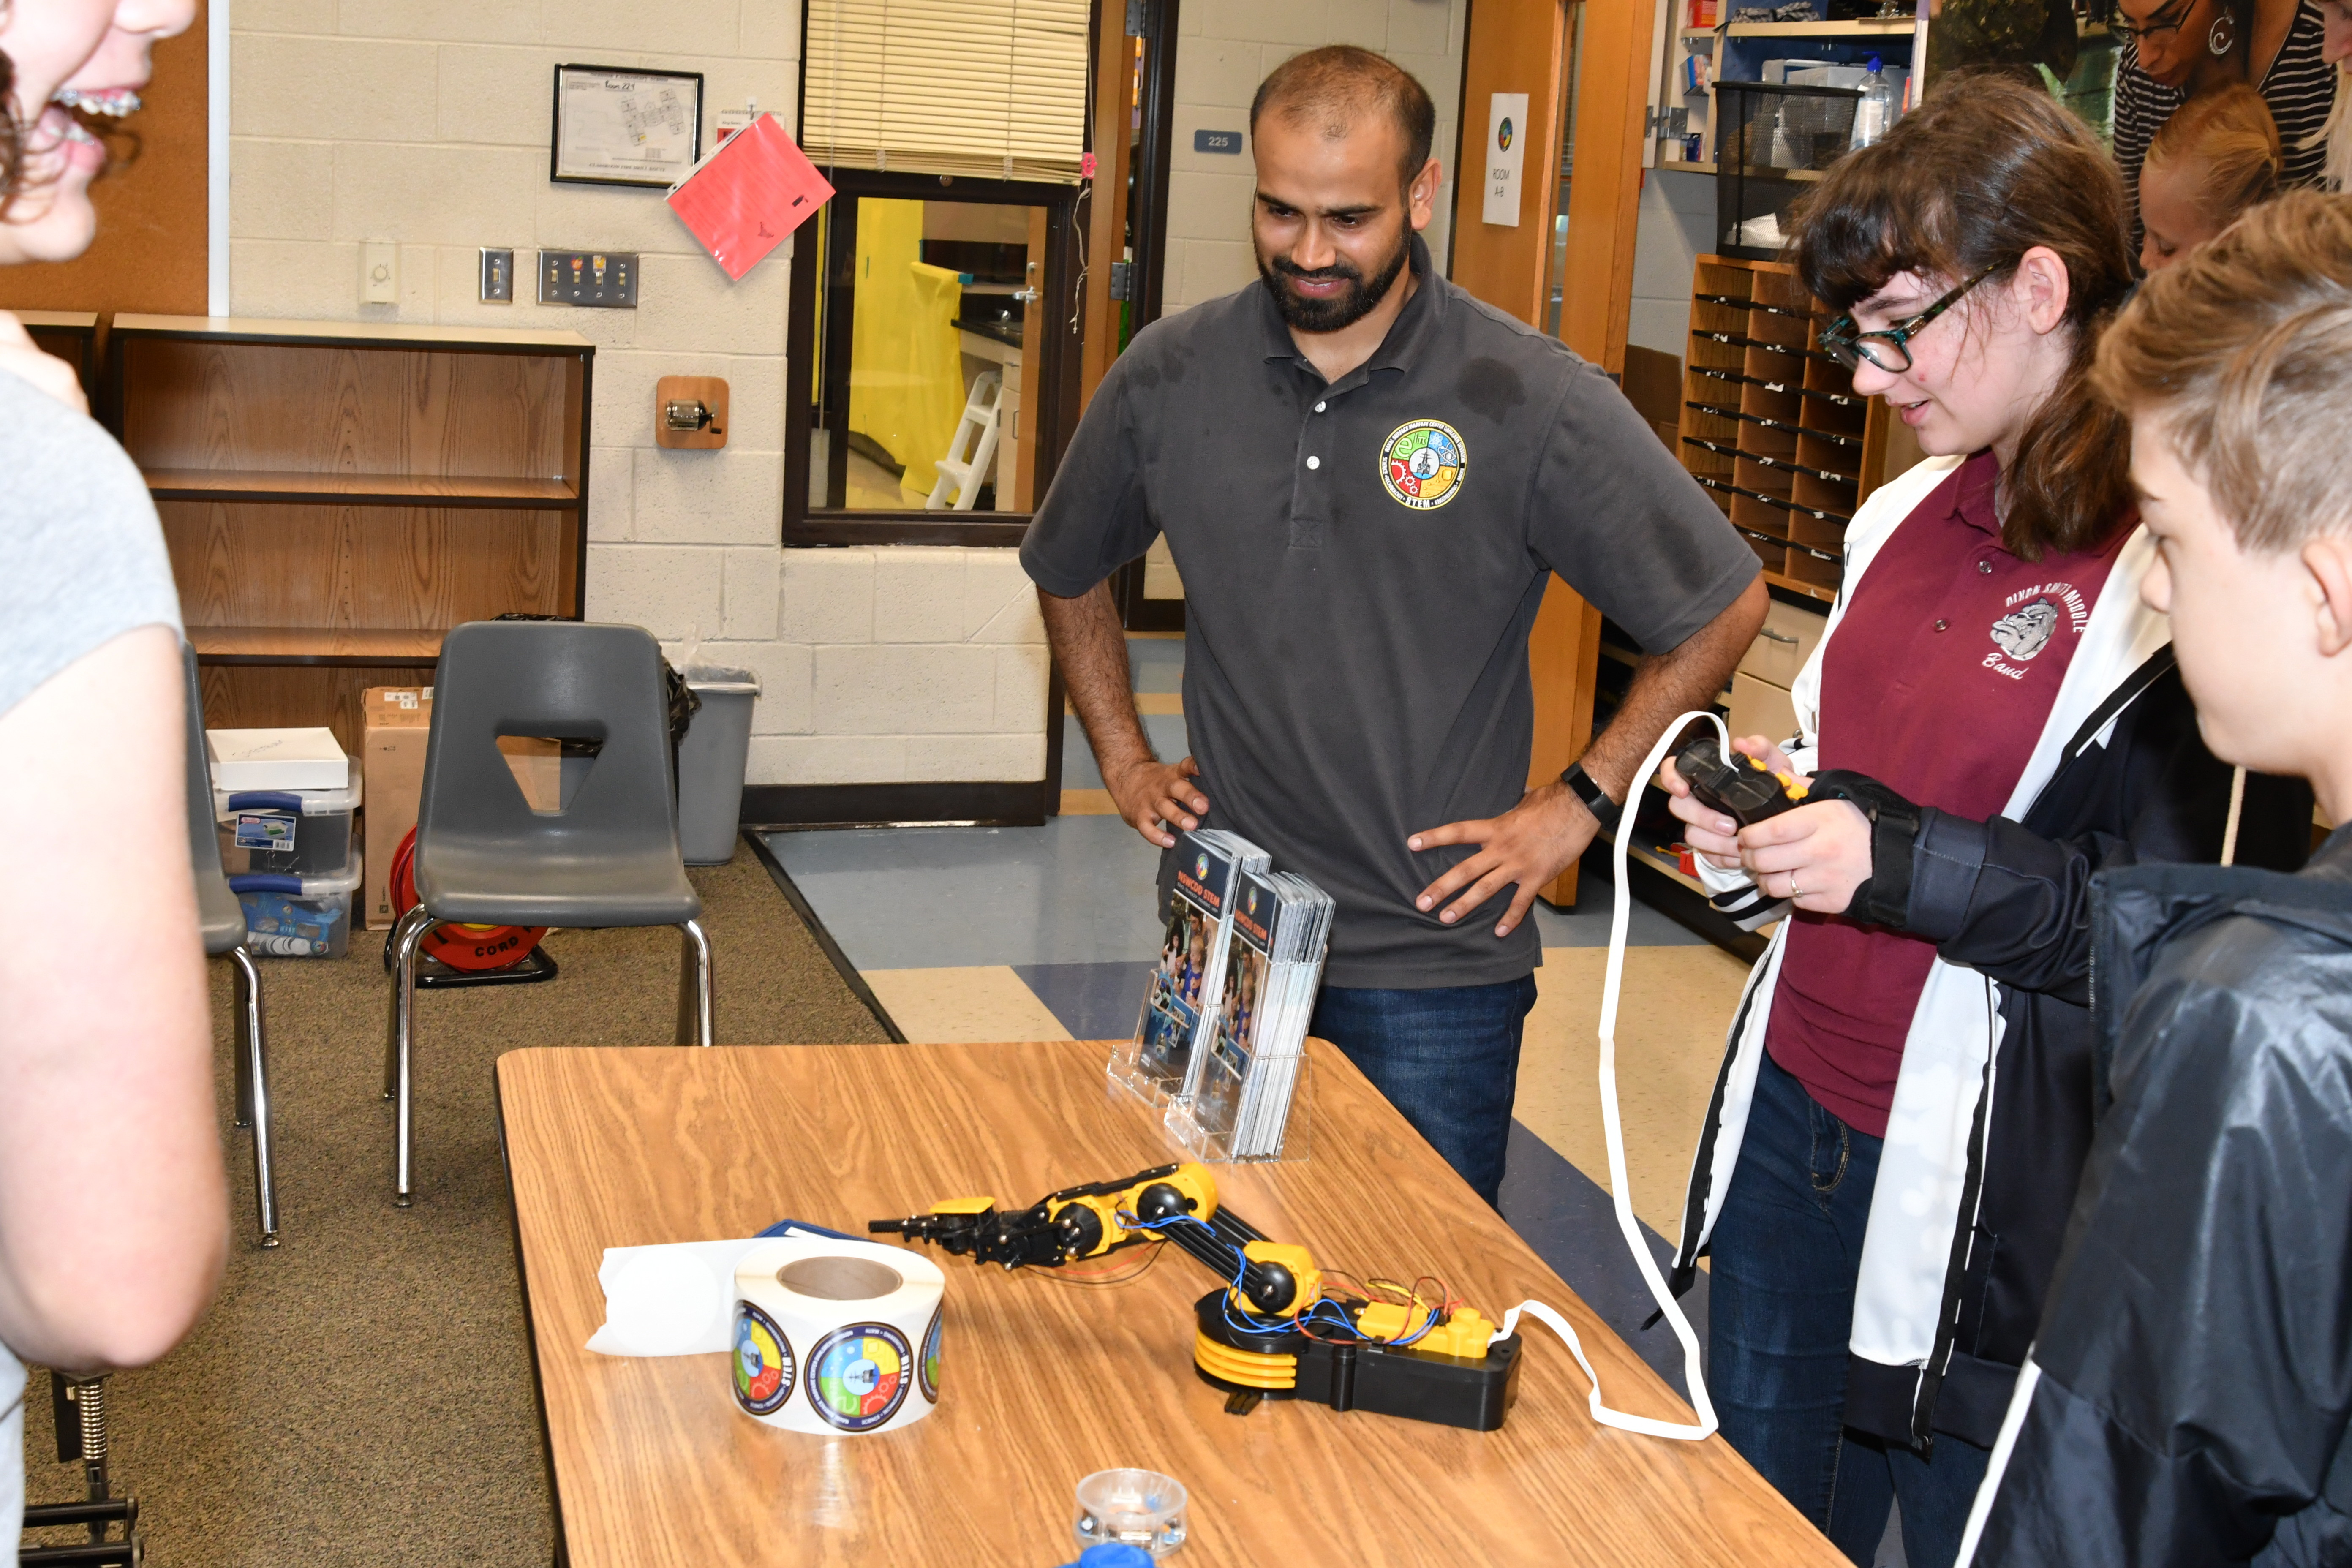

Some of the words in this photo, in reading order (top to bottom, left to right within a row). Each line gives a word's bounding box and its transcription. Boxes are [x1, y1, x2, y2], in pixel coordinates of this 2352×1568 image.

[1209, 136, 1228, 147] 225
[1492, 169, 1510, 180] ROOM
[1494, 186, 1504, 197] A-B
[1392, 425, 1409, 440] SURFACE
[1429, 422, 1445, 430] CENTER
[1405, 496, 1430, 508] STEM
[2062, 589, 2089, 633] MIDDLE
[1982, 653, 2029, 680] Band
[1203, 889, 1220, 907] STEM
[475, 936, 519, 957] CORD
[781, 1357, 792, 1386] STEM
[899, 1354, 910, 1384] STEM
